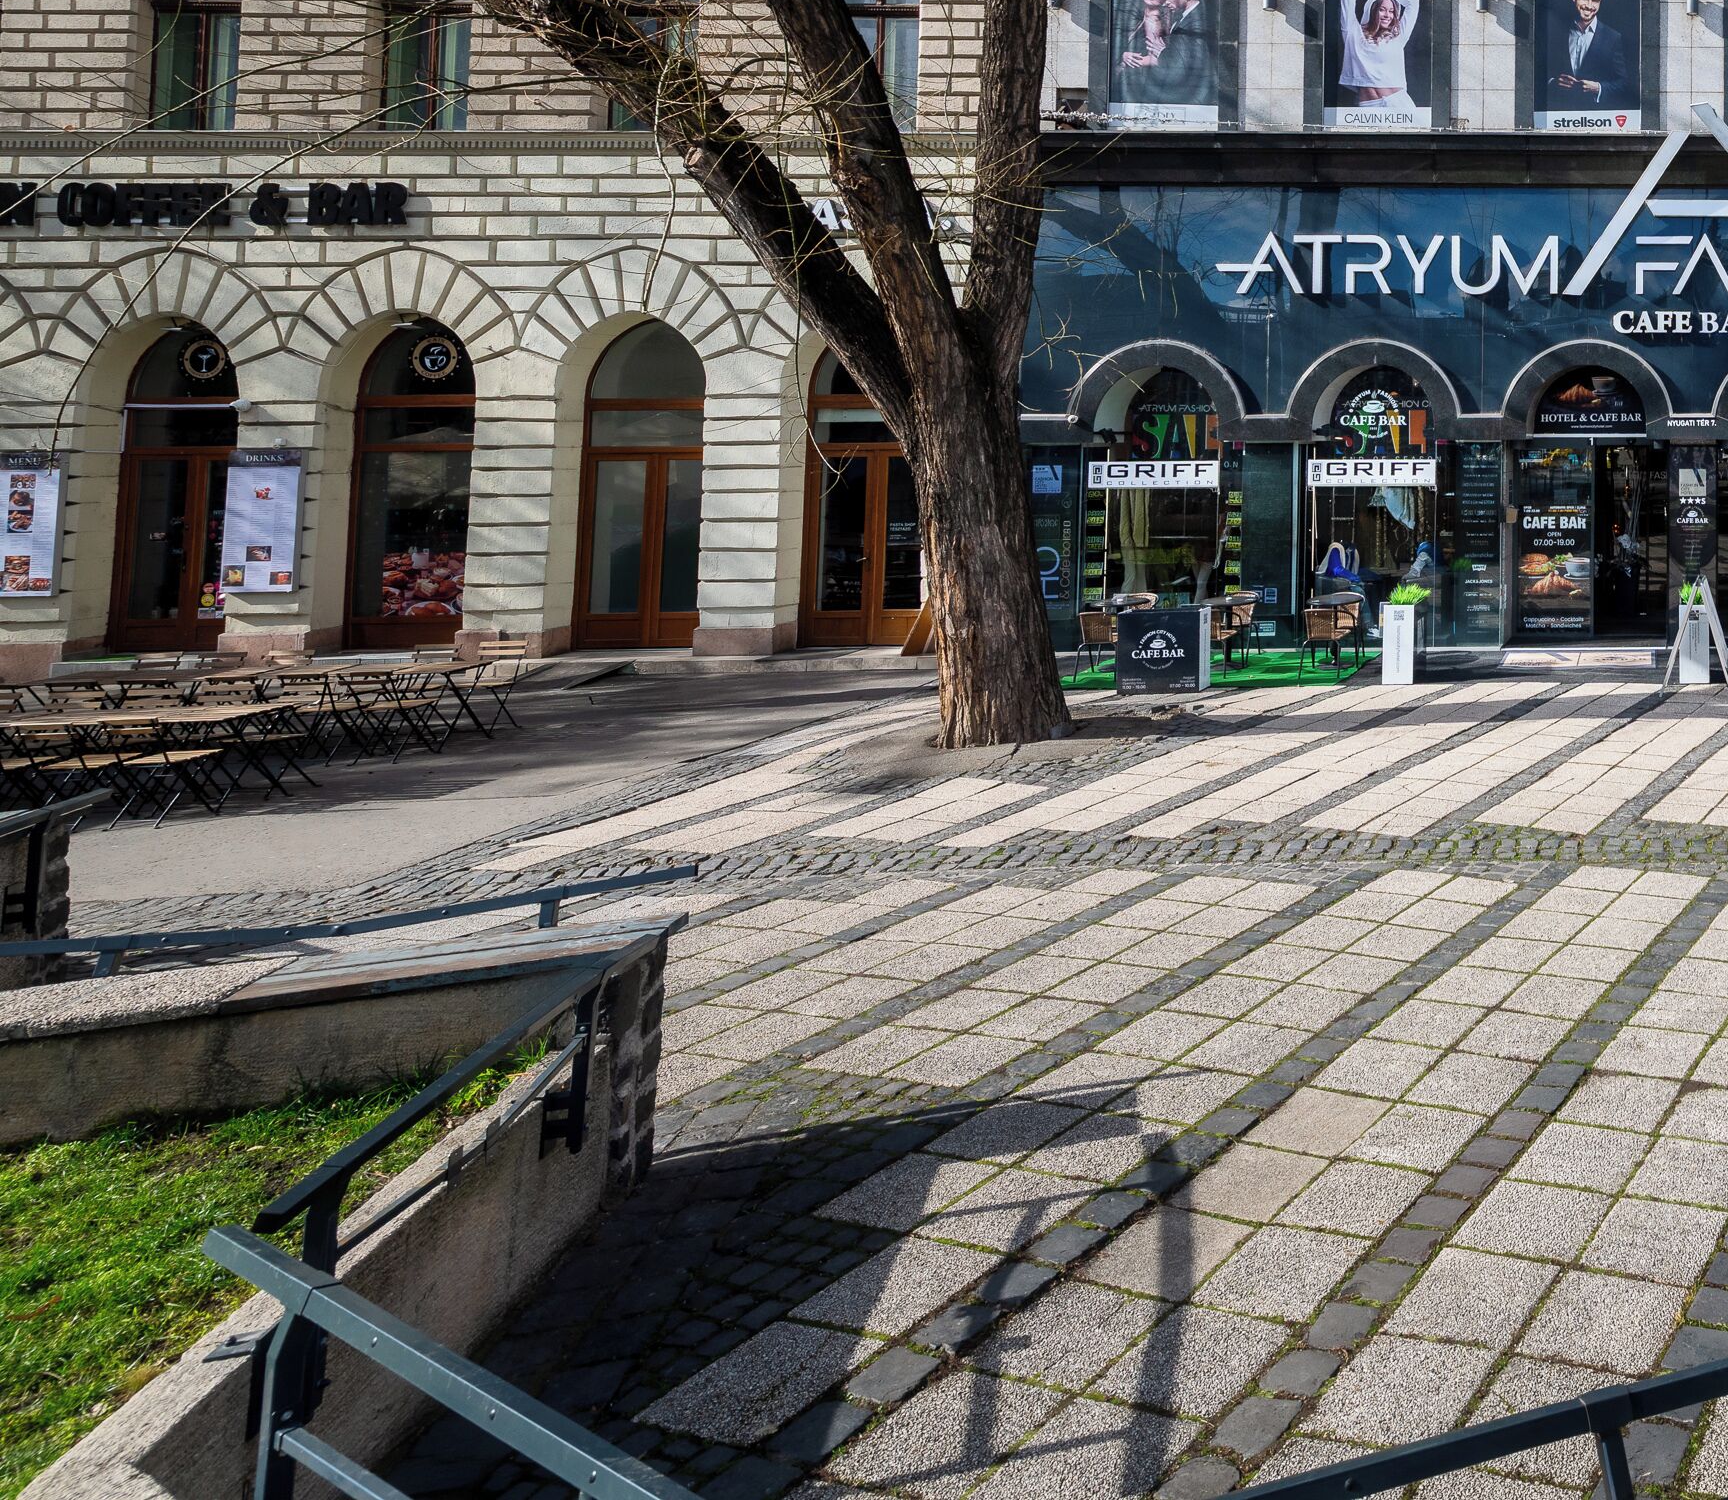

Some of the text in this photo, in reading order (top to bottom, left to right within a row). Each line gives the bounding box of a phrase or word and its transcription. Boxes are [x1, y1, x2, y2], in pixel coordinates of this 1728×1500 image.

[1344, 112, 1413, 124] CALVIN KLEIN
[1553, 116, 1612, 129] strellson
[57, 182, 407, 227] COFFEE & BAR
[1215, 231, 1560, 296] ATRYUM
[1612, 309, 1693, 336] CAFE
[1340, 415, 1407, 426] CAFE BAR
[1541, 413, 1642, 422] HOTEL & CAFE BAR
[1590, 437, 1594, 445] 1
[8, 457, 40, 466] MENU
[246, 454, 283, 463] DRINKS
[1107, 463, 1213, 478] GRIFF
[1327, 462, 1430, 476] GRIFF
[1522, 515, 1587, 530] CAFE BAR
[1533, 538, 1576, 547] 07.00-19.00
[1140, 630, 1156, 645] FASHION
[1166, 632, 1177, 643] HOTEL
[1131, 649, 1185, 659] CAFE BAR
